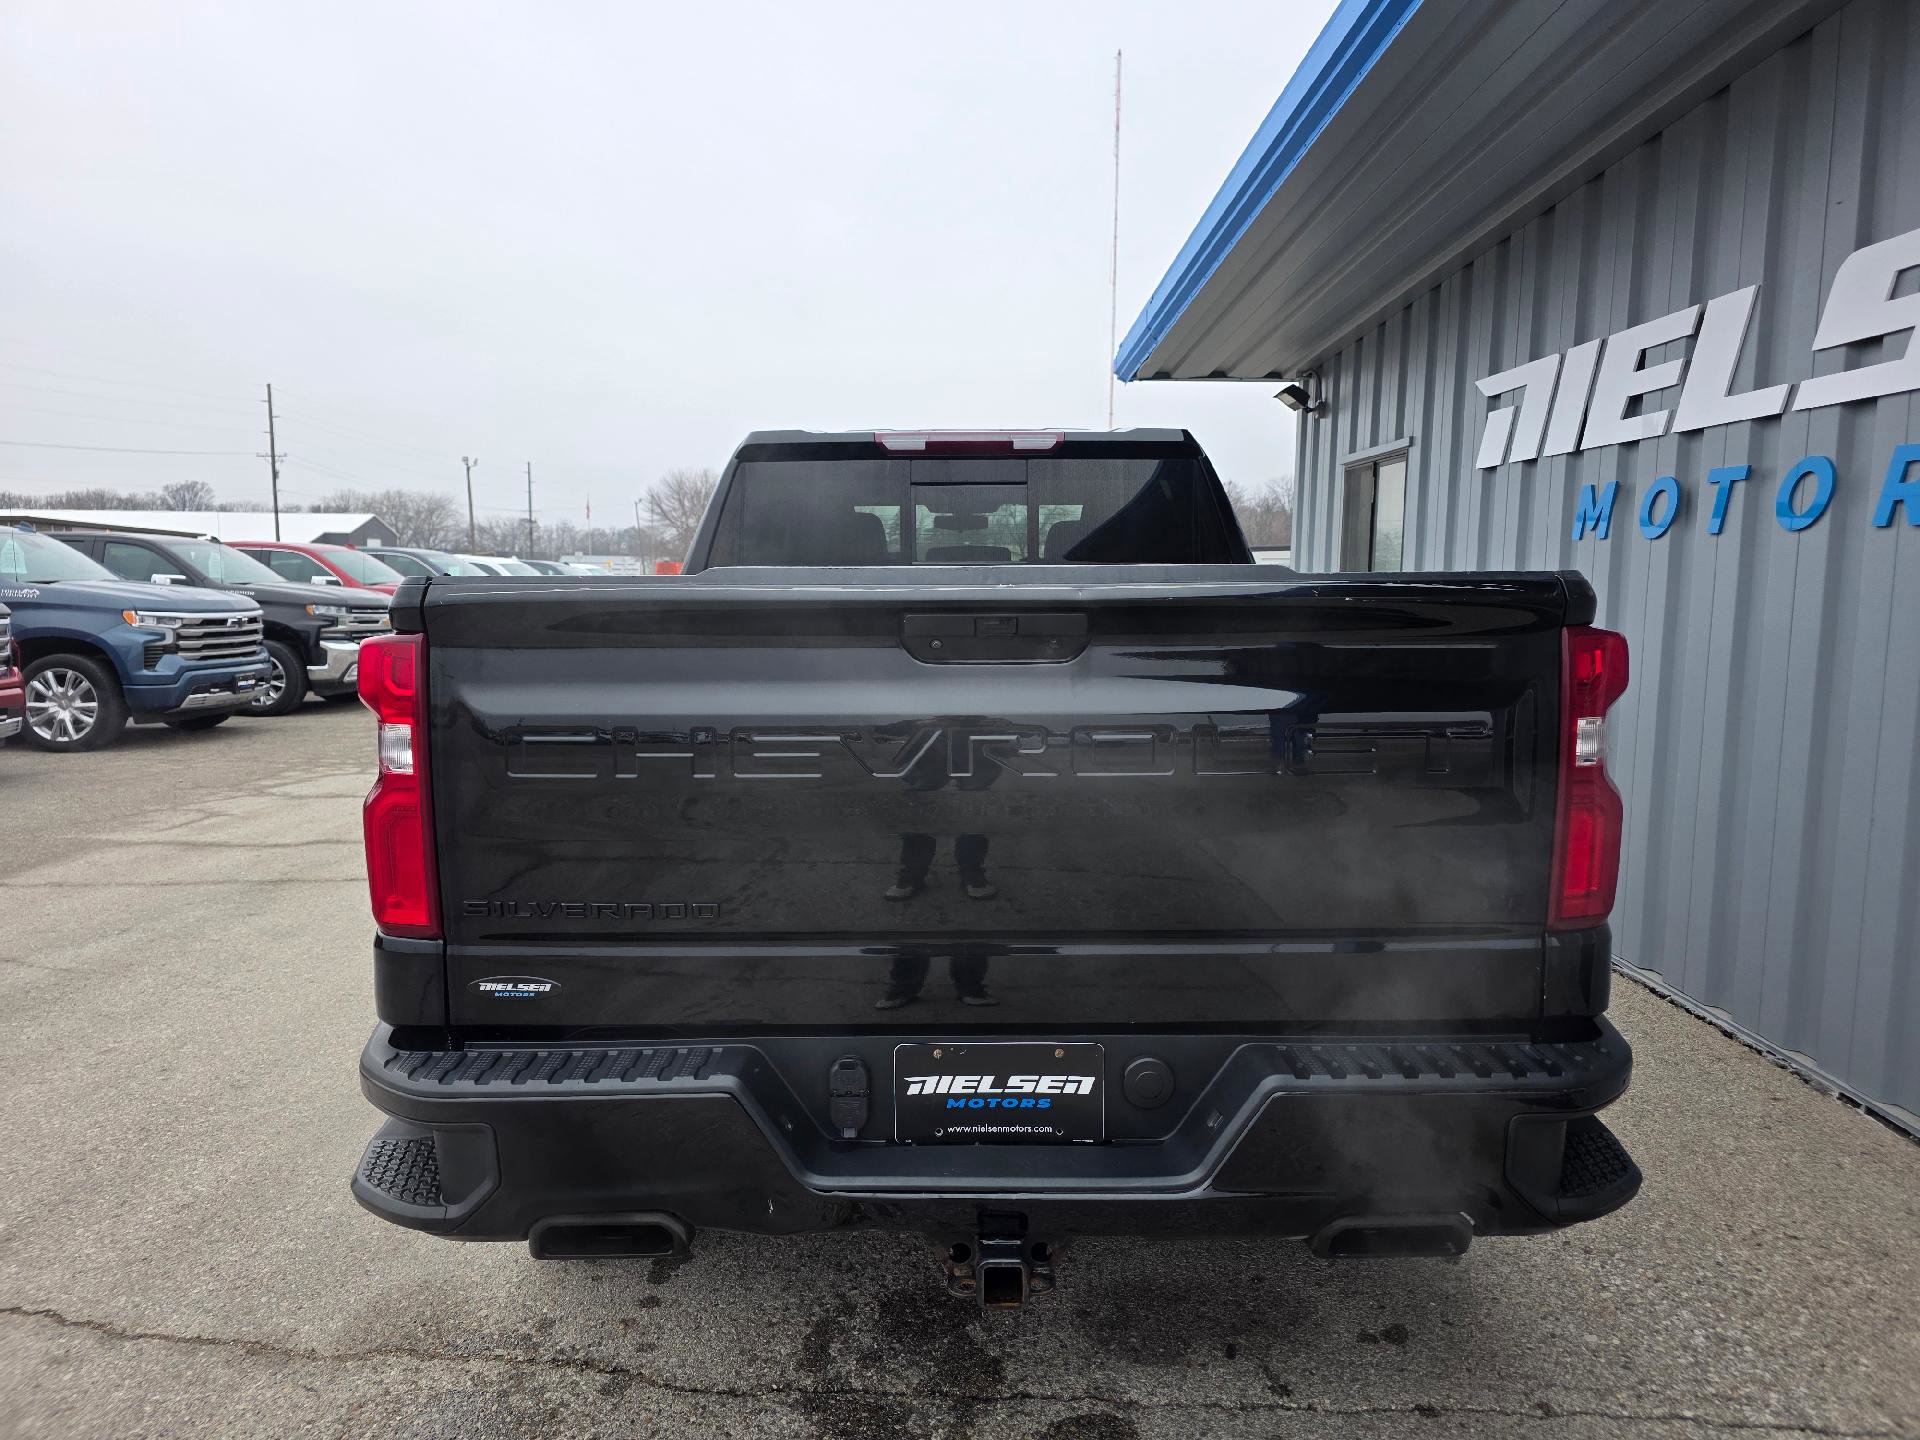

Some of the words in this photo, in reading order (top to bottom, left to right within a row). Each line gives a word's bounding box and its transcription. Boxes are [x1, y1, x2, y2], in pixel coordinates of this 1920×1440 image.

[506, 706, 1495, 778] CHEVROLET
[463, 900, 721, 921] SILVERADO
[478, 982, 552, 992] NIELSEN
[904, 1075, 1096, 1095] NIELSEN
[946, 1098, 1053, 1109] MOTORS
[947, 1124, 1053, 1134] www.nielsenmotors.com
